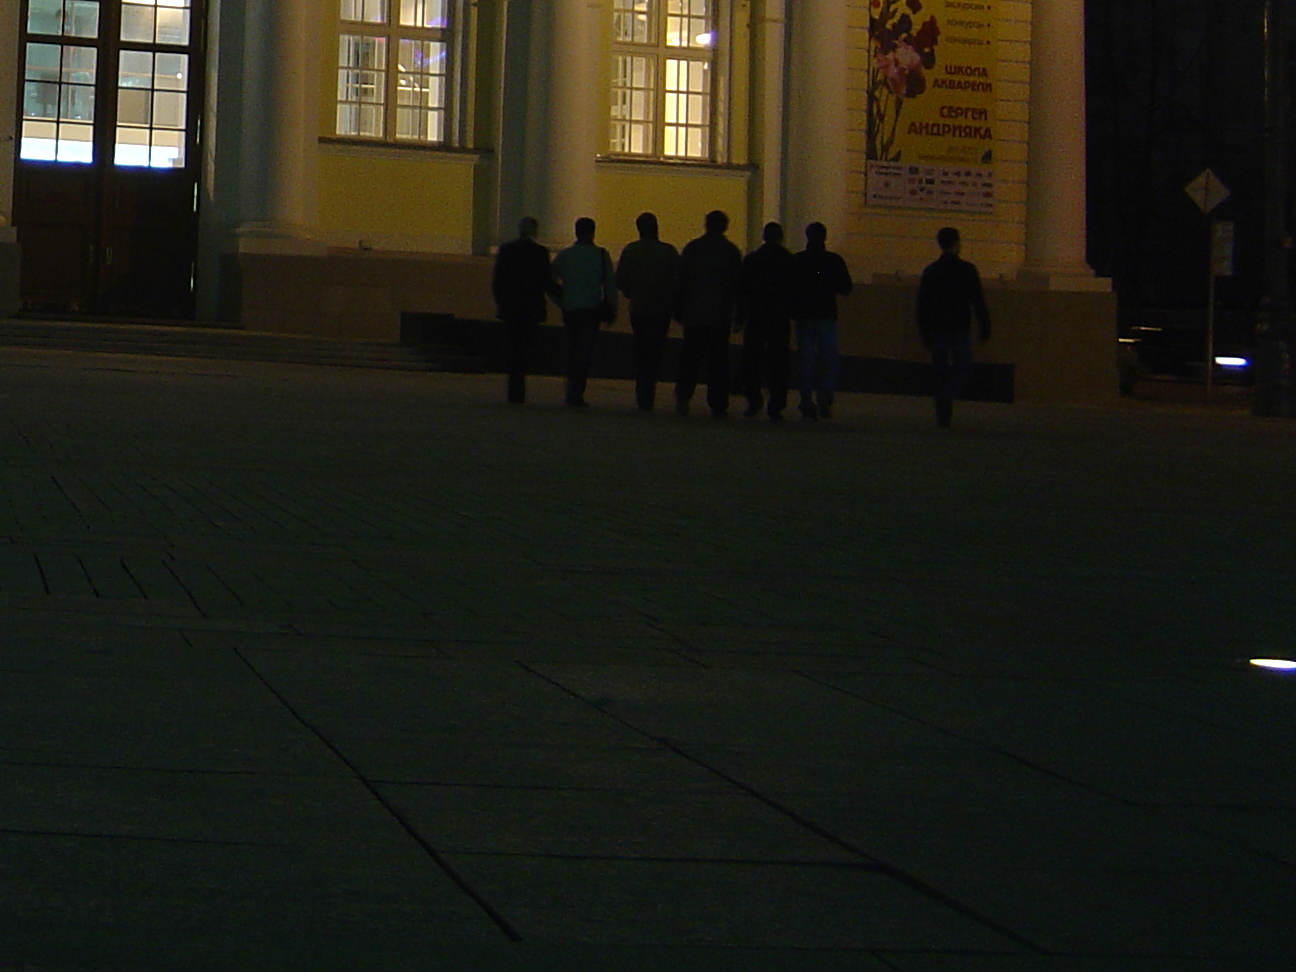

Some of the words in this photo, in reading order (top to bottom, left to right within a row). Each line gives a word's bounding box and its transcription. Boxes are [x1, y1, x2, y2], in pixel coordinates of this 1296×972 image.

[945, 64, 988, 77] ШКОЛА
[932, 78, 992, 92] АКВАРЕЛИ
[939, 105, 988, 120] СЕРГЕЙ
[907, 121, 993, 140] АНДРИЯКА
